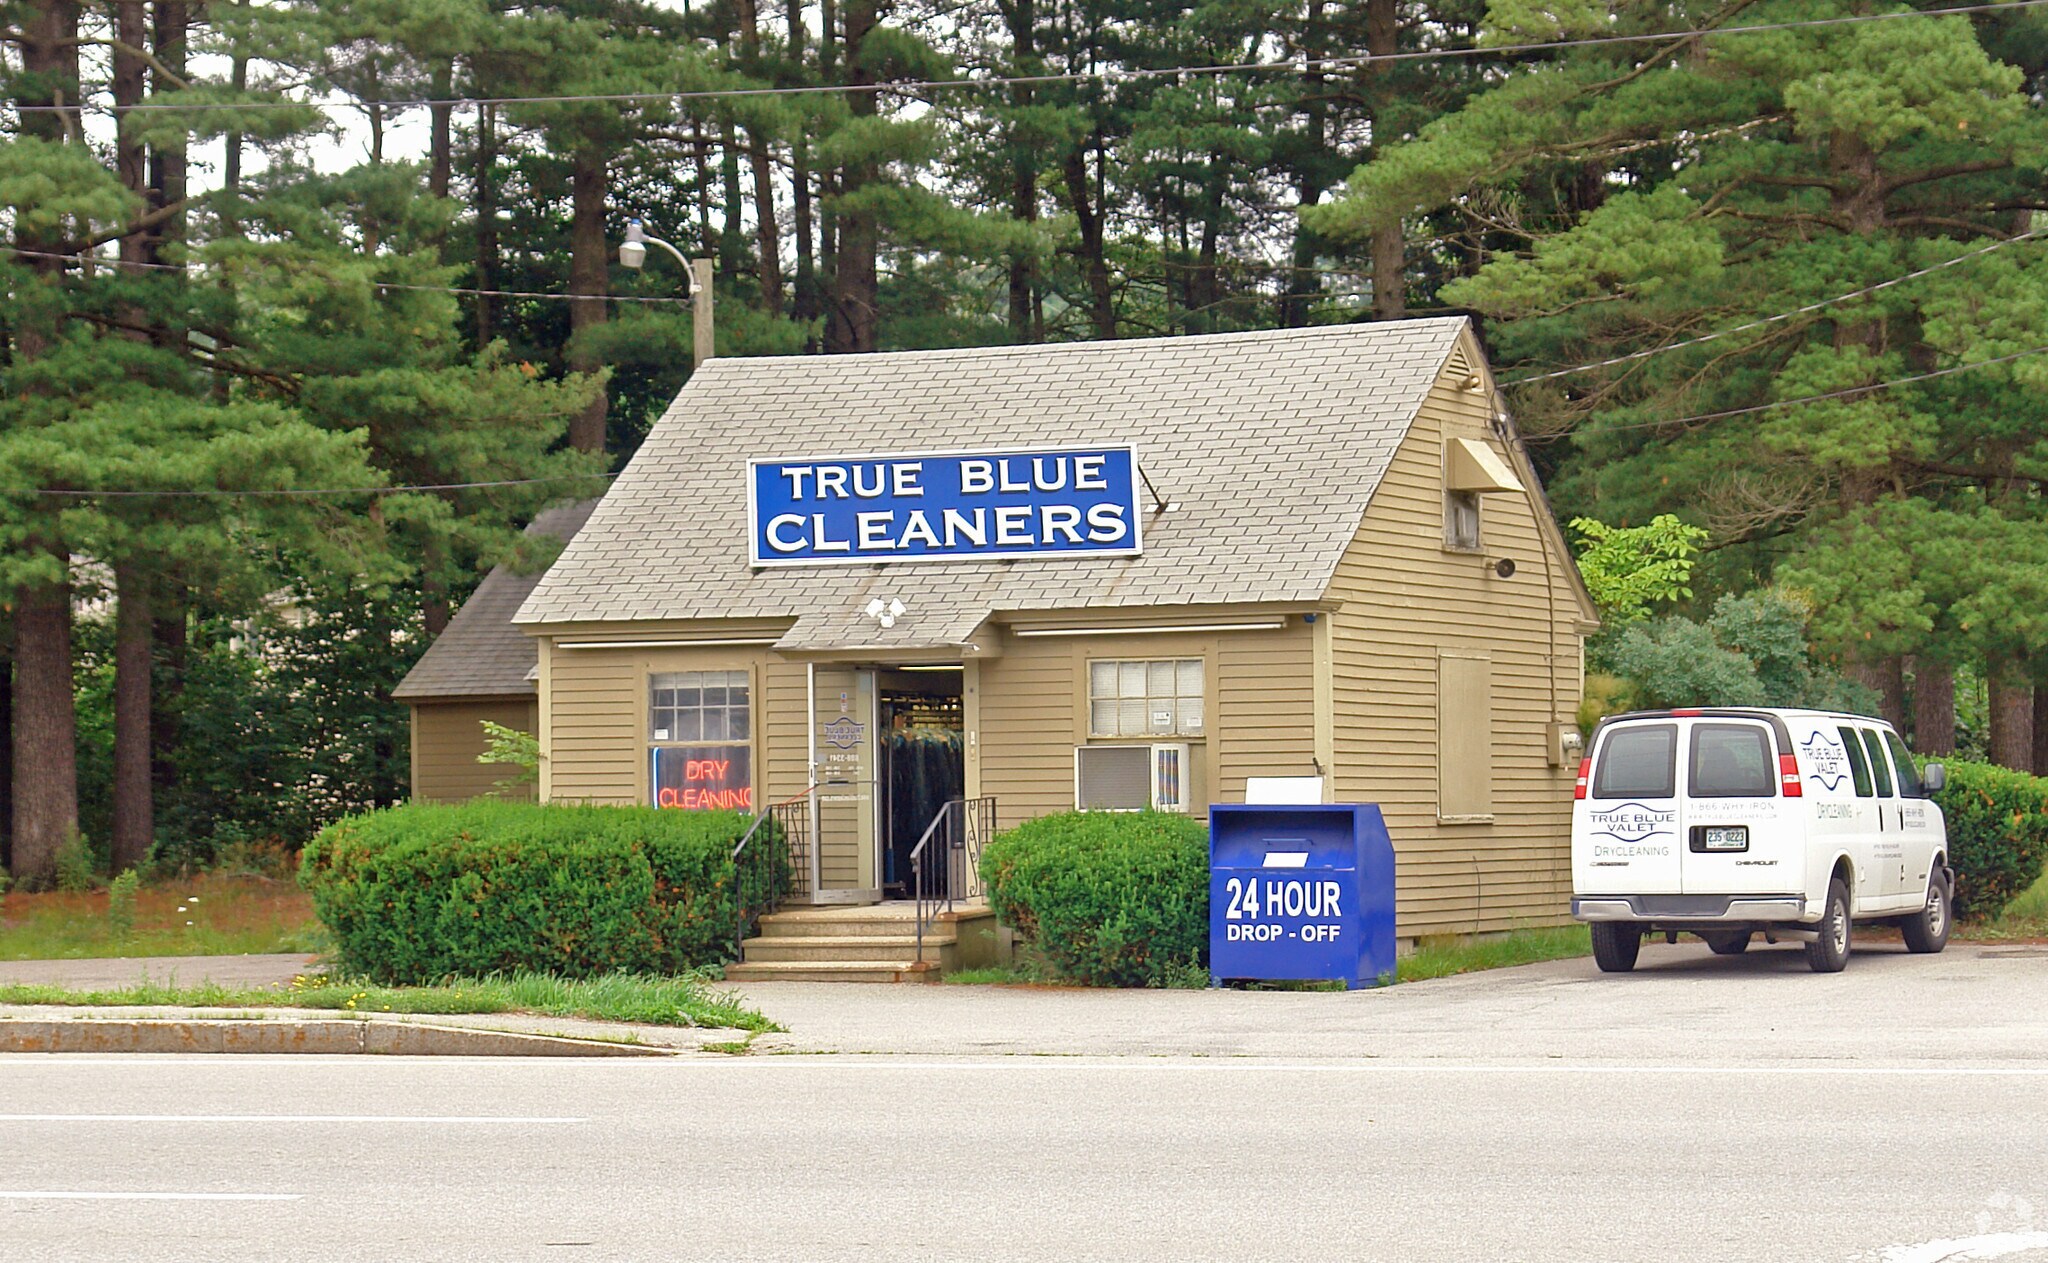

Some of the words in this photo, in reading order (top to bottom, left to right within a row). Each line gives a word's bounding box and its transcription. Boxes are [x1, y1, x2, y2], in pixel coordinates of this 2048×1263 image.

[781, 462, 924, 499] TRUE
[960, 454, 1107, 494] BLUE
[766, 503, 1127, 552] CLEANERS
[685, 760, 729, 780] DRY
[1590, 814, 1630, 823] TRUE
[1633, 813, 1676, 823] BLUE
[1607, 823, 1656, 832] VALET
[1594, 845, 1669, 857] DRYCLEANING
[1225, 877, 1260, 920] 24
[1266, 880, 1342, 917] HOUR
[1226, 924, 1283, 942] DROP
[1300, 924, 1341, 942] OFF
